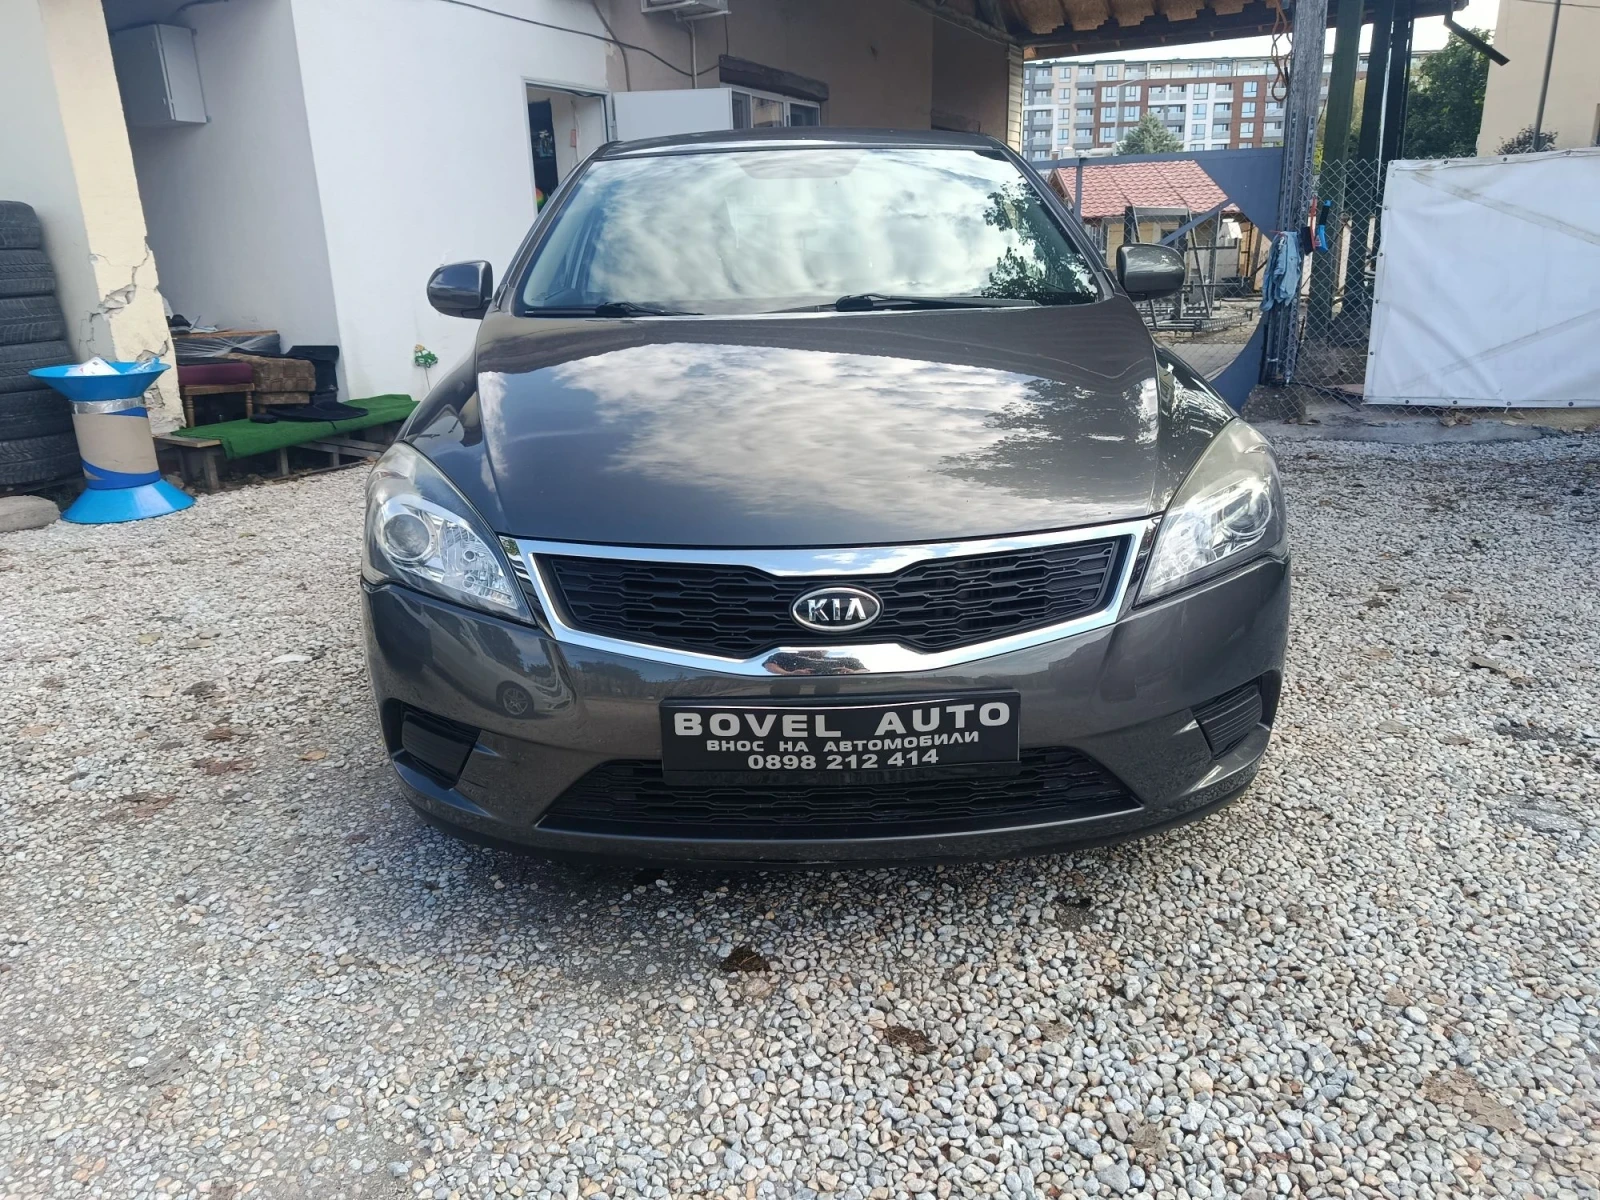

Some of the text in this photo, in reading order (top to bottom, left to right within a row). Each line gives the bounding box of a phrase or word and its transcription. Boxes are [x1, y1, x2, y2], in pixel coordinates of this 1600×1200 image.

[807, 597, 867, 622] KIA
[673, 701, 1011, 738] BOVEL AUTO
[706, 730, 979, 752] ВНОС НА АВТОМОБИЛИ
[747, 748, 939, 770] 0898 212 414
